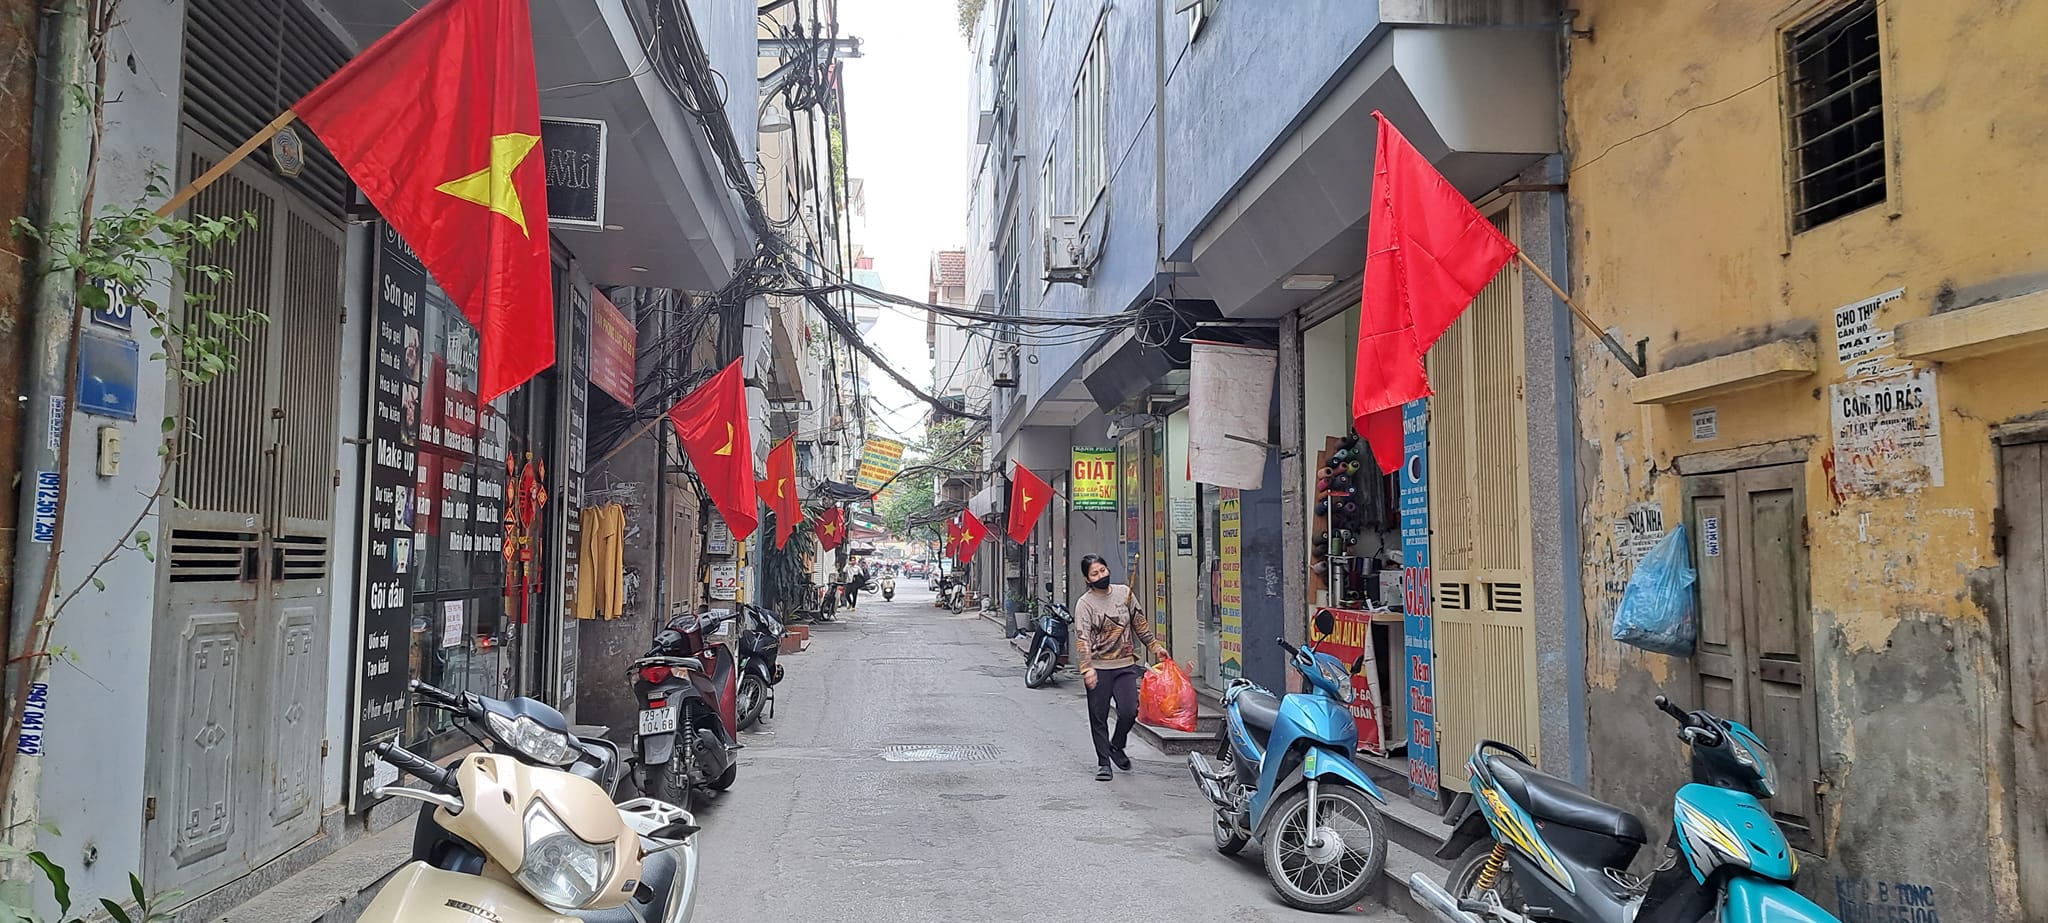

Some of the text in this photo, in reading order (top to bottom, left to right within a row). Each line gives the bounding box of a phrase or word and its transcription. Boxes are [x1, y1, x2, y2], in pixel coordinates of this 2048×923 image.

[104, 279, 127, 318] 58
[384, 274, 417, 317] Sơn gel
[1836, 309, 1856, 328] CHO
[379, 375, 390, 392] Hoa
[378, 401, 400, 423] Phụ kiện
[377, 438, 402, 469] Make
[404, 450, 415, 477] up
[1074, 456, 1115, 484] GIẶT
[34, 472, 60, 542] 0912.561.250
[383, 488, 394, 505] tiệc
[372, 540, 388, 559] Party
[715, 577, 735, 588] 5.2
[371, 579, 404, 615] Gội đầu
[380, 630, 390, 650] sấy
[367, 655, 390, 680] Tạo kiểu
[1410, 686, 1432, 716] Thảm
[16, 683, 48, 755] 0947 041 842
[645, 708, 670, 722] 29-Y7
[445, 898, 503, 923] HONDA
